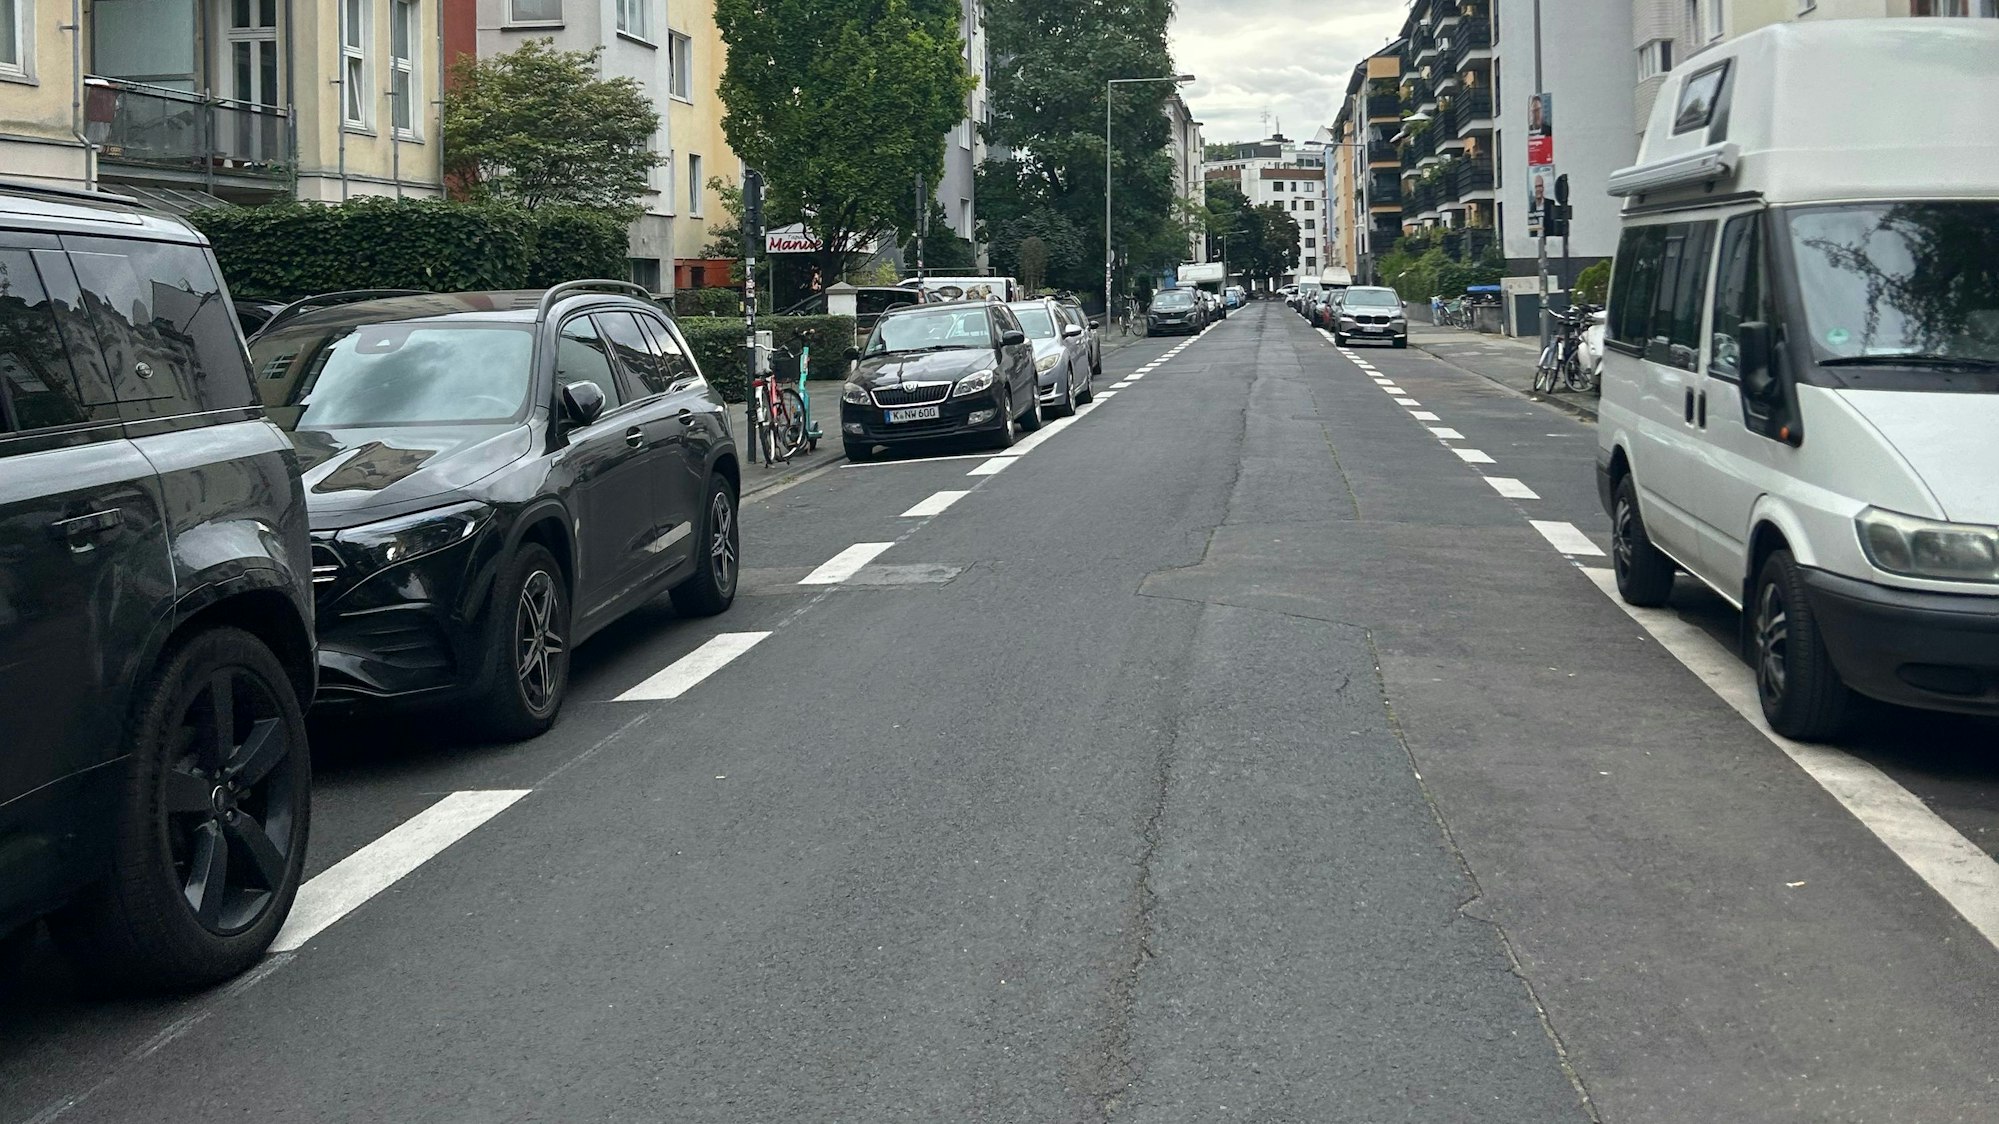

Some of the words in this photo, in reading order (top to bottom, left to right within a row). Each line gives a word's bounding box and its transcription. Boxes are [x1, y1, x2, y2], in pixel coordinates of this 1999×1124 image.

[893, 411, 900, 420] K
[904, 410, 917, 420] NW
[919, 408, 936, 417] 600
